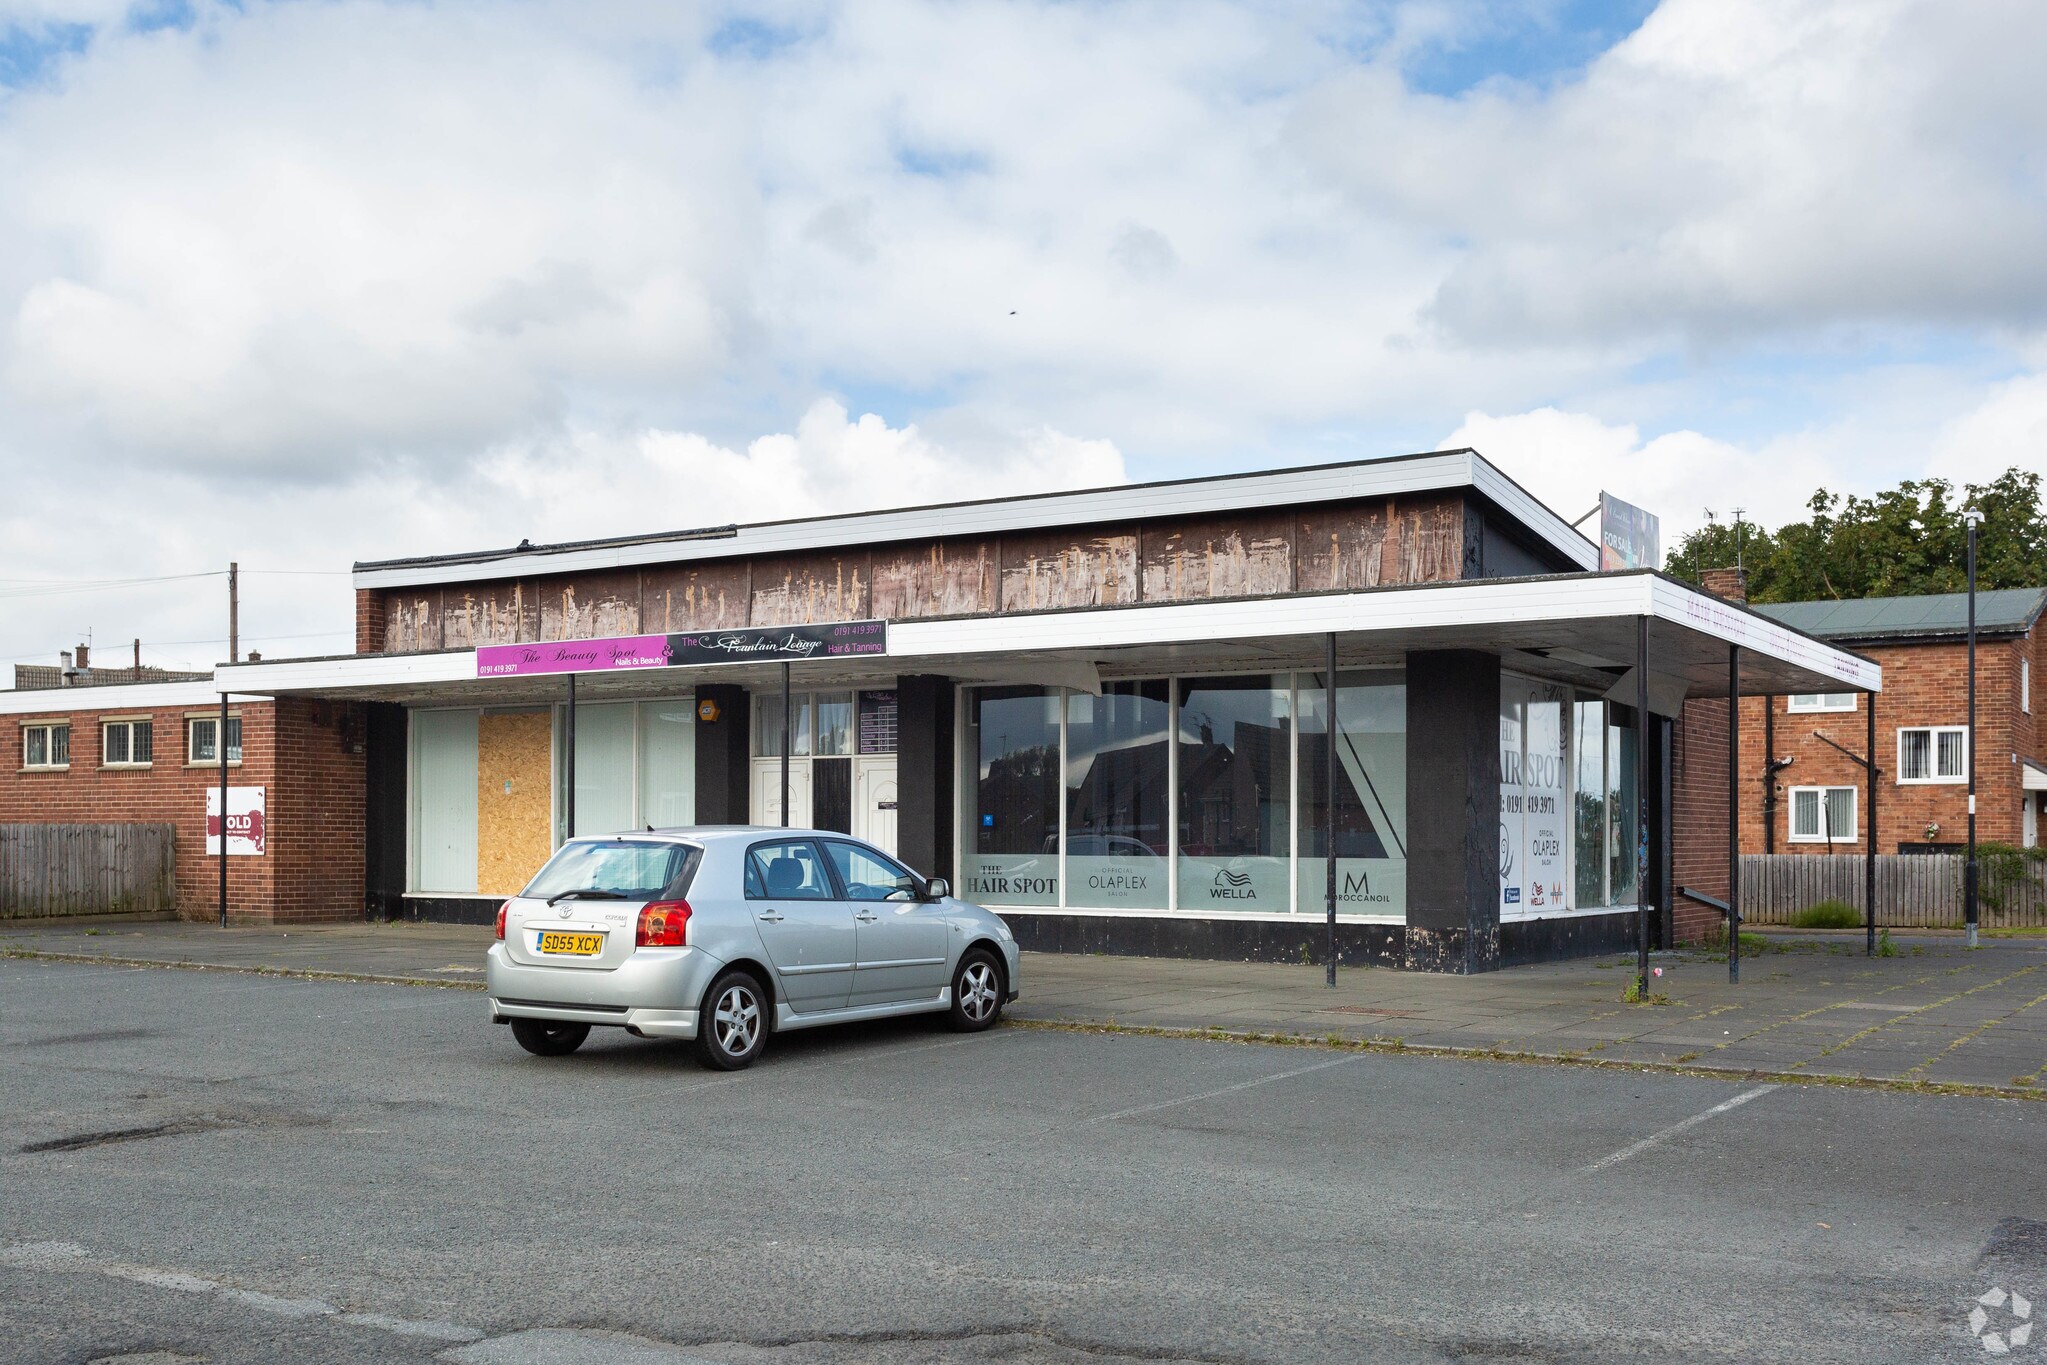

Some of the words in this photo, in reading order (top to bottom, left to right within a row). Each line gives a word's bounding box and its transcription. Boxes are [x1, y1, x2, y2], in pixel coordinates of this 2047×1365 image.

[1604, 532, 1617, 549] FOR
[834, 627, 850, 637] 0191
[852, 626, 865, 635] 419
[866, 624, 882, 634] 3971
[682, 637, 698, 646] The
[699, 633, 777, 653] Fountain
[779, 633, 822, 657] Lounge
[828, 644, 843, 653] Hair
[844, 643, 851, 653] &
[852, 642, 882, 653] Tanning
[514, 648, 541, 664] The
[548, 647, 598, 664] Beauty
[604, 645, 637, 663] Spot
[662, 644, 674, 657] &
[615, 658, 631, 666] Nails
[640, 656, 664, 666] Beauty
[480, 665, 493, 674] 0191
[494, 665, 505, 673] 419
[505, 664, 518, 672] 3971
[1501, 720, 1515, 742] HE
[1528, 752, 1564, 789] SPOT
[1506, 794, 1523, 814] 0191
[1540, 796, 1555, 815] 3971
[226, 816, 252, 829] OLD
[1533, 839, 1560, 856] OLAPLEX
[981, 865, 1002, 875] THE
[967, 877, 1009, 893] HAIR
[1013, 878, 1057, 894] SPOT
[1089, 875, 1147, 889] OLAPLEX
[1210, 888, 1257, 899] WELLA
[544, 935, 574, 951] SD55
[577, 936, 600, 951] XCX
